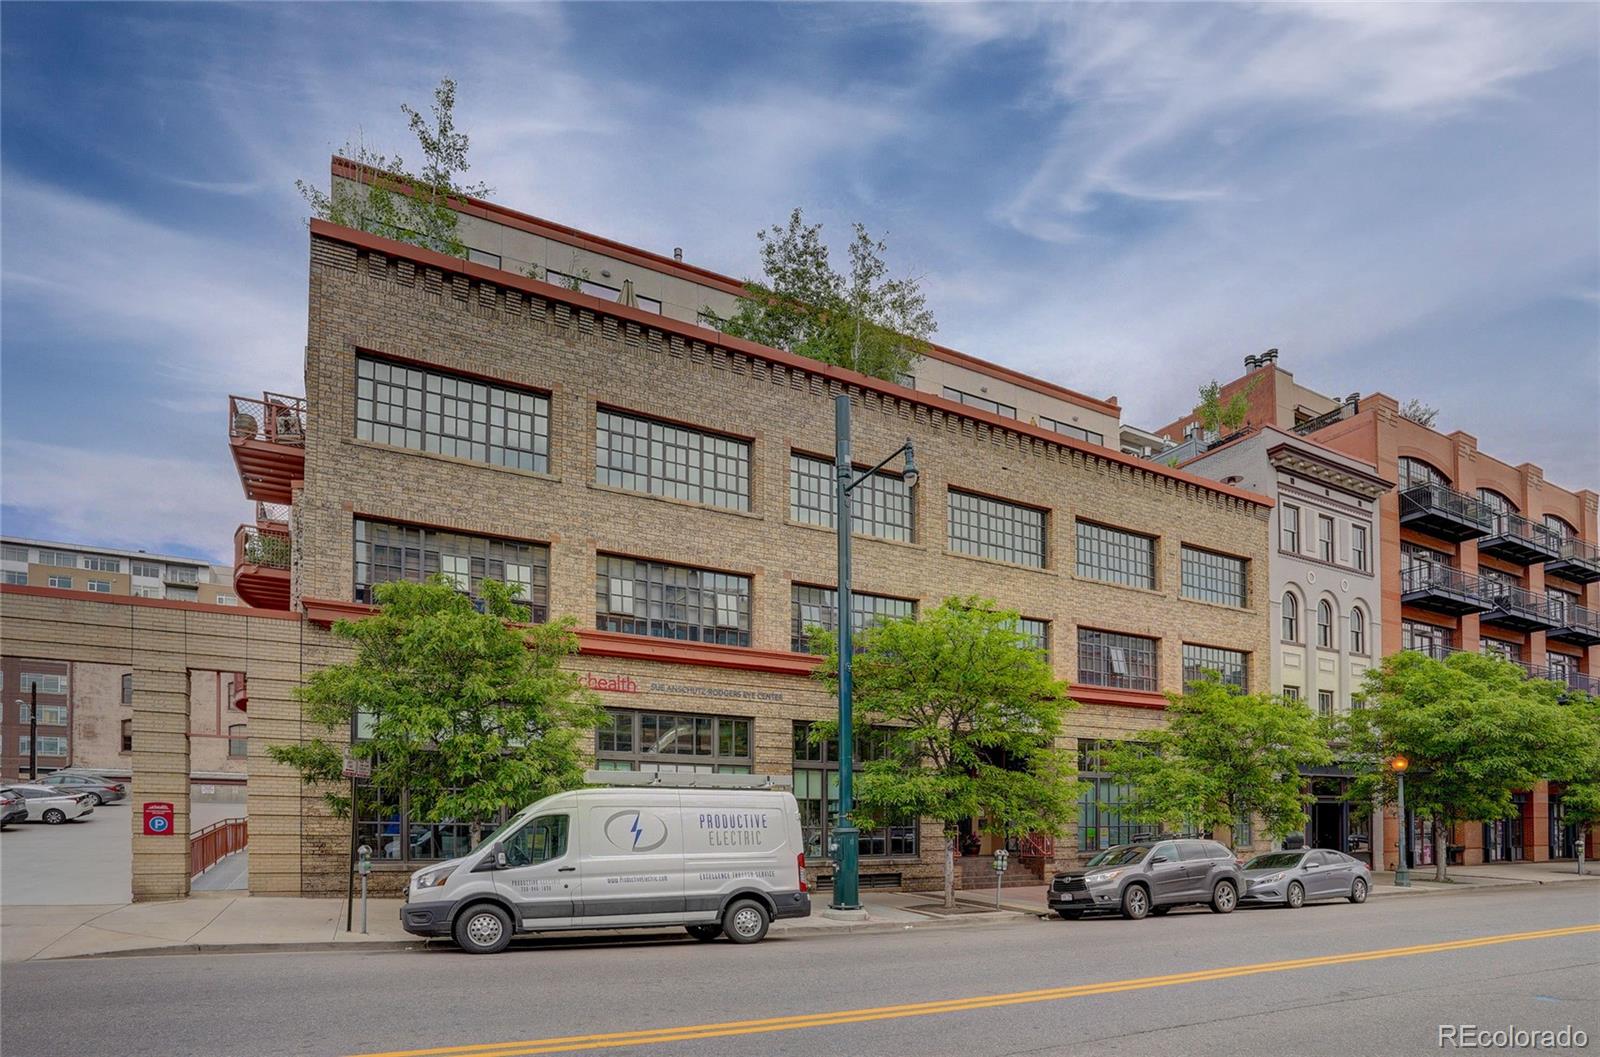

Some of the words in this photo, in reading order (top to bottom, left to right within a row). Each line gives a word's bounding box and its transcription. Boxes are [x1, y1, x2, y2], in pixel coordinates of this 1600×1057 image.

[650, 682, 665, 692] SUE
[757, 691, 784, 701] CENTER
[155, 819, 164, 829] P
[699, 813, 768, 829] PRODUCTIVE
[708, 830, 762, 846] ELECTRIC
